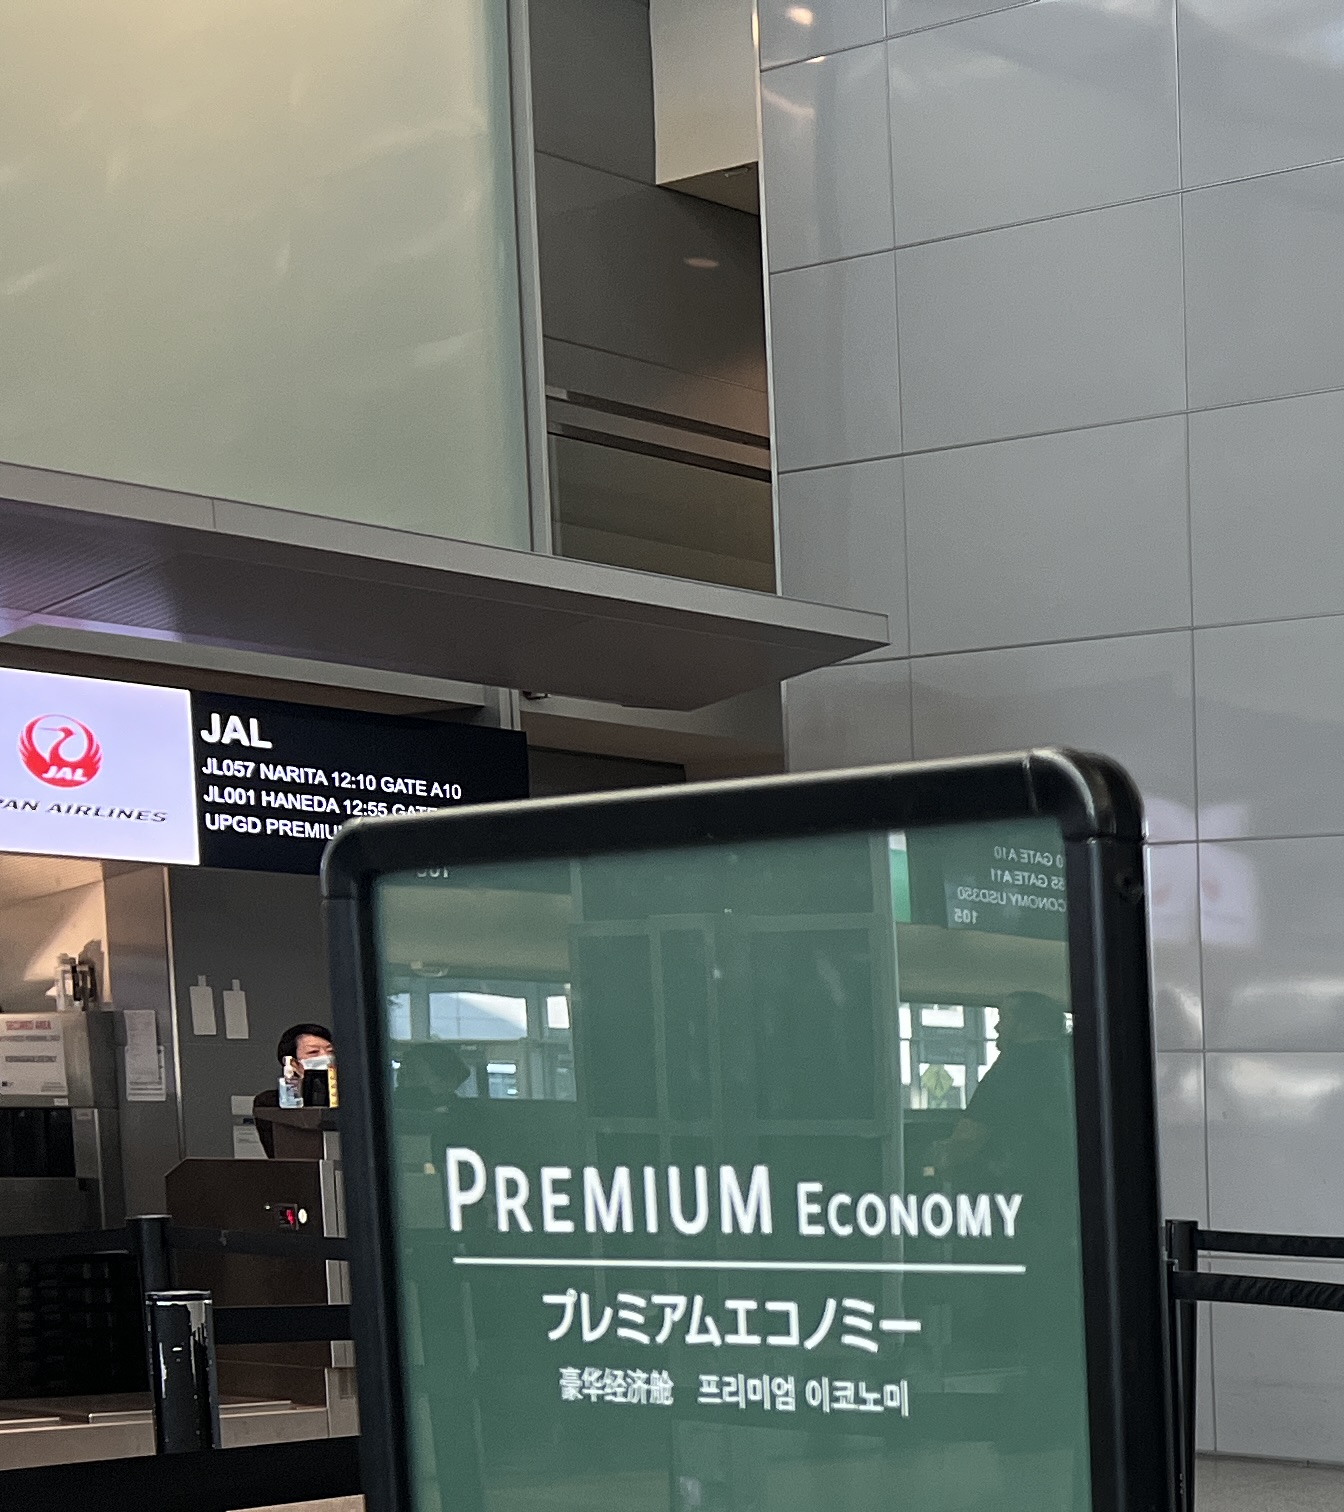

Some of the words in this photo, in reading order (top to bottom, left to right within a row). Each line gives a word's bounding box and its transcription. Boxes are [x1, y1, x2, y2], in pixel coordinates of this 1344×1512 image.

[200, 713, 273, 749] JAL
[41, 765, 88, 781] JAL
[202, 757, 255, 778] JL057
[260, 764, 328, 785] NARITA
[331, 771, 377, 791] 12:10
[381, 776, 426, 797] GATE
[430, 782, 461, 800] A10
[0, 798, 40, 811] AN
[45, 802, 168, 823] AIRLINES
[203, 785, 255, 806] JL001
[261, 791, 340, 814] HANEDA
[343, 799, 388, 817] 12:55
[205, 813, 261, 834] UPGD
[266, 819, 342, 840] PREMIU
[445, 1147, 772, 1236] PREMIUM
[796, 1181, 1024, 1239] ECONOMY
[541, 1288, 922, 1353] プレミアムエコノミー
[698, 1372, 796, 1411] 프리미엄
[805, 1376, 909, 1417] 이코노미
